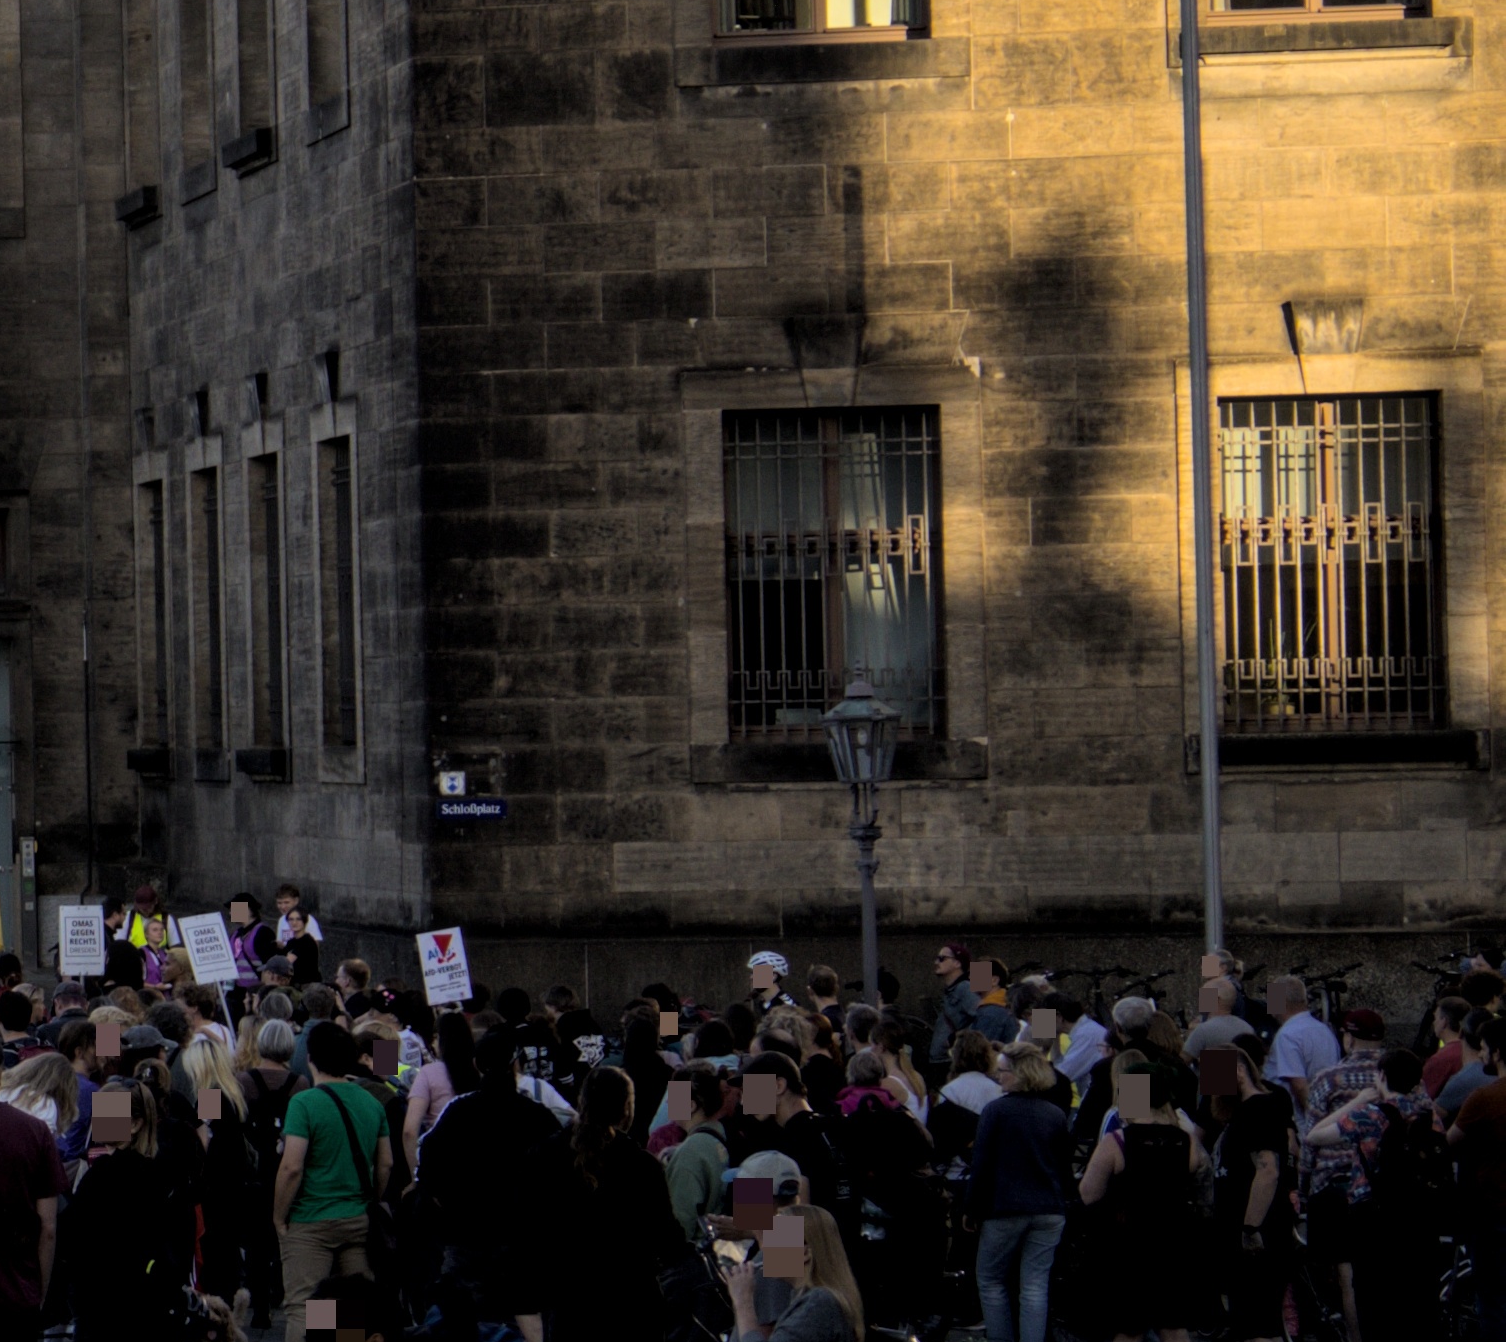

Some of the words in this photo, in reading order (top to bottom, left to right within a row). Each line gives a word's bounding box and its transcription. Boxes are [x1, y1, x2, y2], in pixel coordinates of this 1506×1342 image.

[441, 803, 501, 816] Schloßplatz
[194, 927, 216, 936] OMAS
[195, 936, 219, 945] GEGEN
[197, 944, 223, 954] RECHTS
